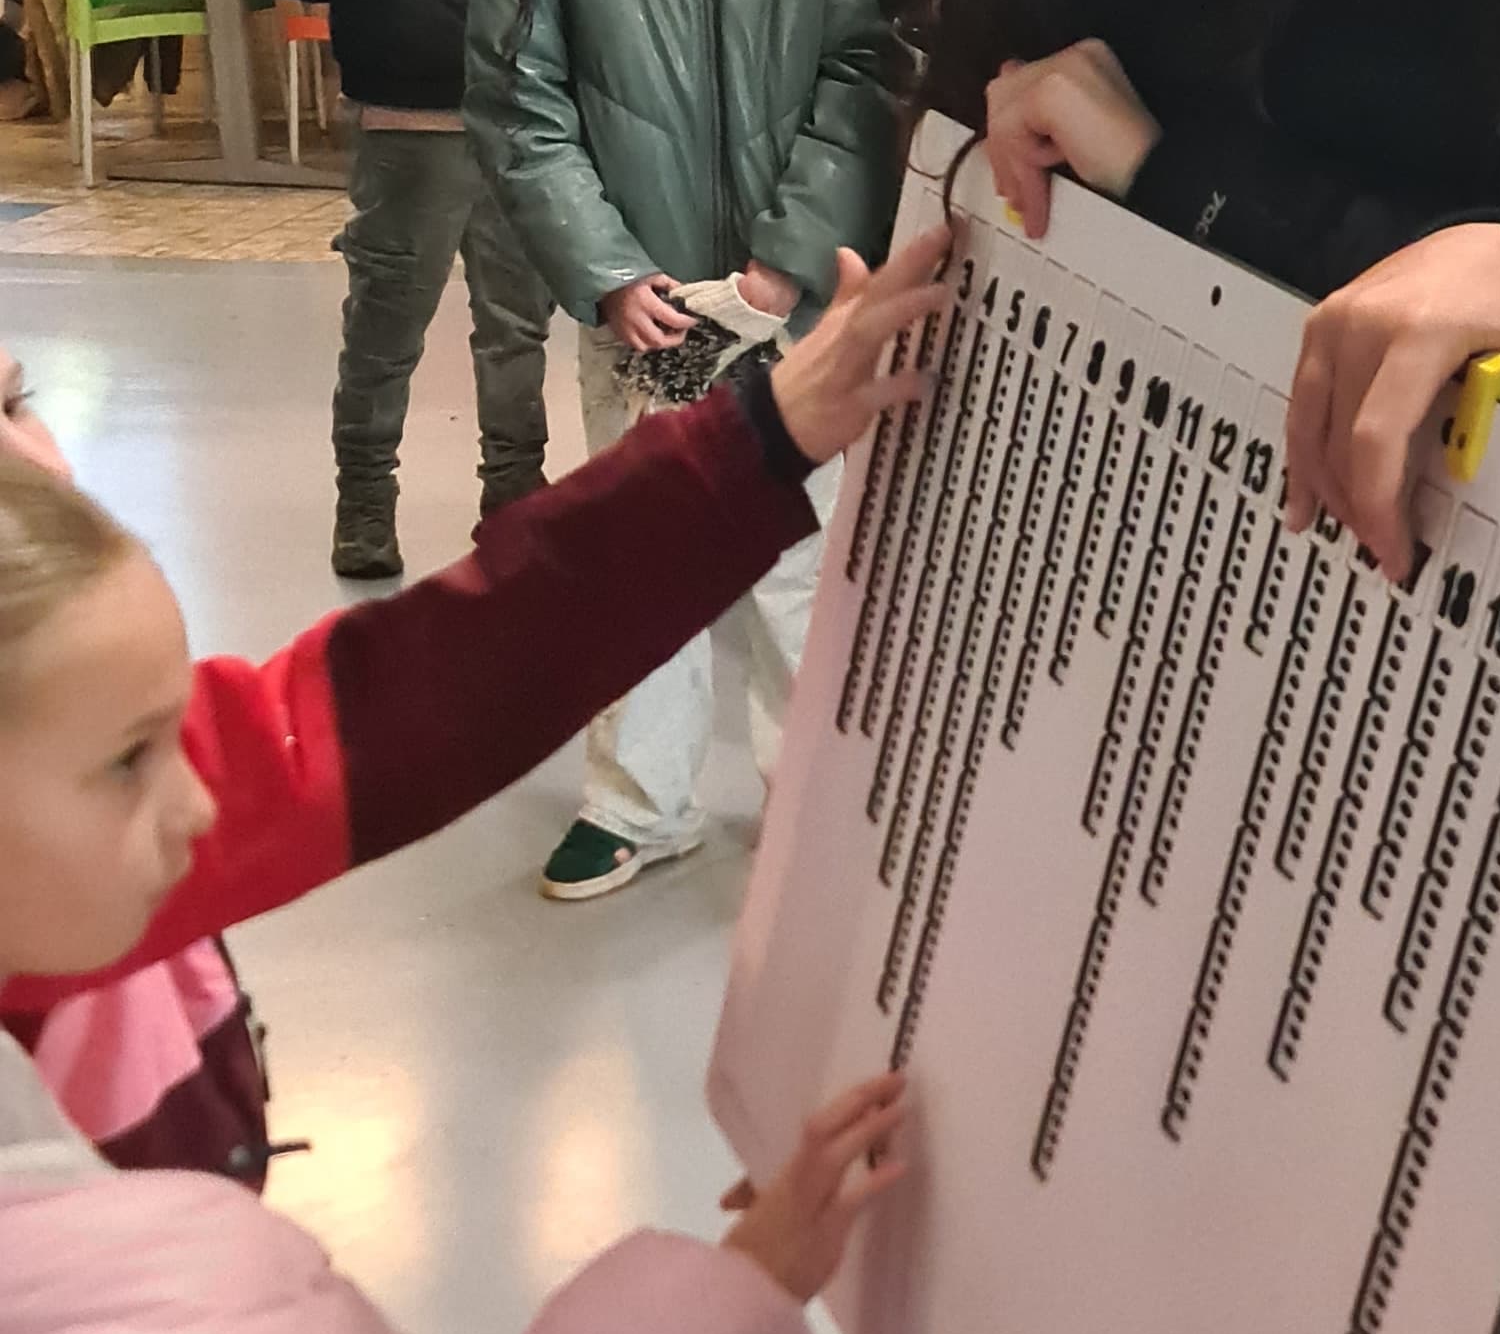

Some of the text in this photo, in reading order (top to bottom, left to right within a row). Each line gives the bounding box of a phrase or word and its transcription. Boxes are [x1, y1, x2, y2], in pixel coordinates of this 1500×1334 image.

[983, 276, 999, 317] 4
[1006, 289, 1025, 332] 5
[1032, 305, 1051, 350] 6
[1060, 322, 1079, 366] 7
[1087, 340, 1106, 385] 8
[1115, 358, 1135, 405] 9
[1142, 376, 1170, 429] 10
[1176, 397, 1204, 451] 11
[1209, 418, 1238, 475] 12
[1243, 438, 1273, 494] 13
[1438, 563, 1474, 629] 18
